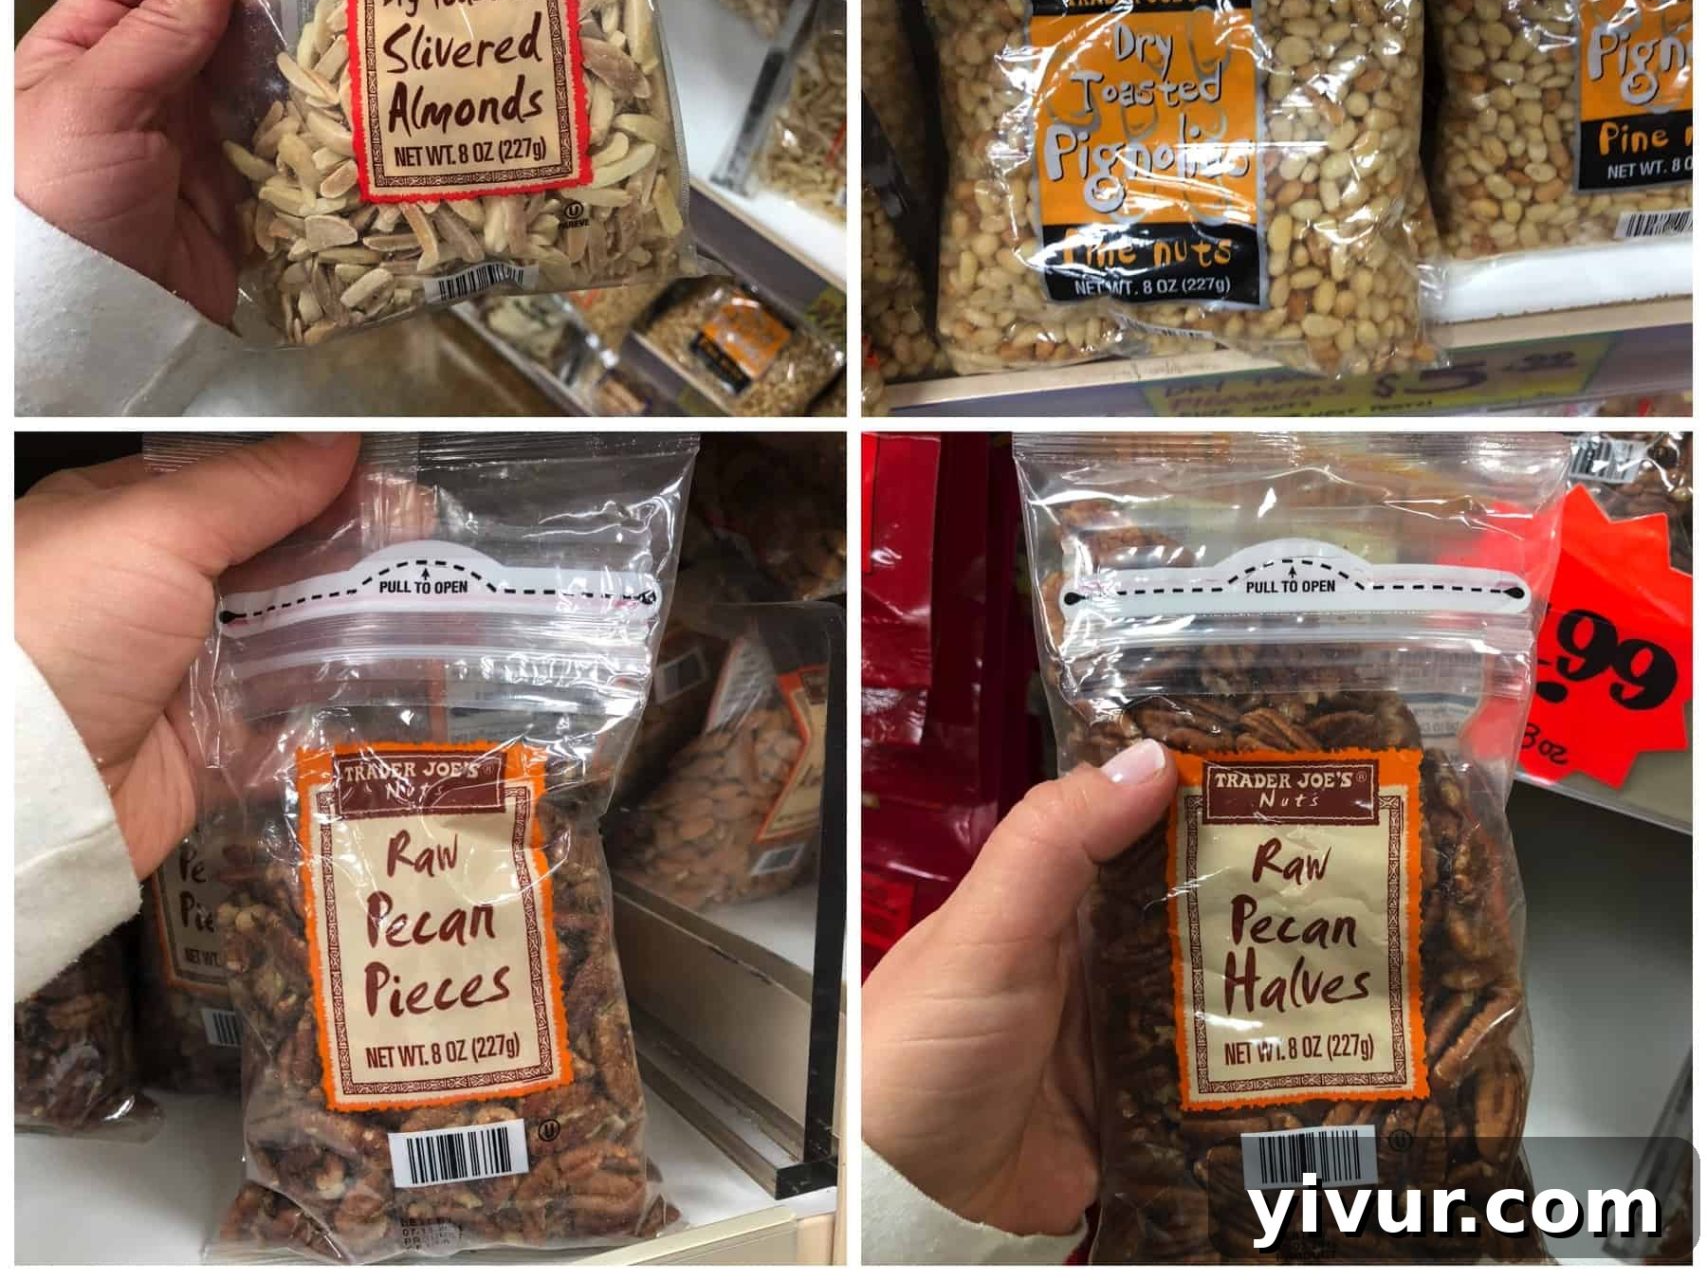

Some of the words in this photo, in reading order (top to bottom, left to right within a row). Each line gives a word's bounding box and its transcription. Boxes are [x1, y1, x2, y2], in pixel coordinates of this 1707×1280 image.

[383, 11, 543, 73] Slivered
[1115, 22, 1173, 81] Dry
[1070, 61, 1223, 112] Toasted
[388, 74, 544, 137] Almonds
[394, 146, 424, 168] NET
[425, 144, 456, 166] WT.
[458, 143, 469, 164] 8
[472, 141, 494, 162] OZ
[498, 136, 547, 163] (227g)
[1600, 121, 1669, 156] Pine
[1608, 163, 1636, 179] NET
[1640, 160, 1667, 177] WT.
[1672, 158, 1681, 172] 8
[1154, 239, 1232, 268] nuts
[1143, 279, 1152, 293] 8
[1157, 278, 1178, 293] OZ
[1182, 275, 1231, 295] (227g)
[379, 580, 411, 594] PULL
[414, 581, 431, 594] TO
[434, 580, 468, 594] OPEN
[1246, 581, 1278, 594] PULL
[1281, 580, 1298, 593] TO
[1302, 580, 1336, 593] OPEN
[344, 762, 417, 782] TRADER
[422, 761, 480, 778] JOE'S
[1214, 773, 1292, 789] TRADER
[1297, 771, 1354, 789] JOE'S
[1259, 789, 1321, 808] Nuts
[387, 829, 458, 877] Raw
[1252, 837, 1332, 885] Raw
[367, 891, 496, 948] Pecan
[1231, 894, 1357, 949] Pecan
[364, 962, 511, 1017] Pieces
[1224, 947, 1371, 1015] Halves
[366, 1046, 395, 1069] NET
[398, 1044, 429, 1067] WT.
[432, 1043, 442, 1064] 8
[446, 1040, 468, 1062] OZ
[472, 1032, 520, 1063] (227g)
[1224, 1042, 1251, 1066] NET
[1289, 1038, 1298, 1059] 8
[1303, 1036, 1323, 1058] OZ
[1327, 1033, 1374, 1061] (227g)
